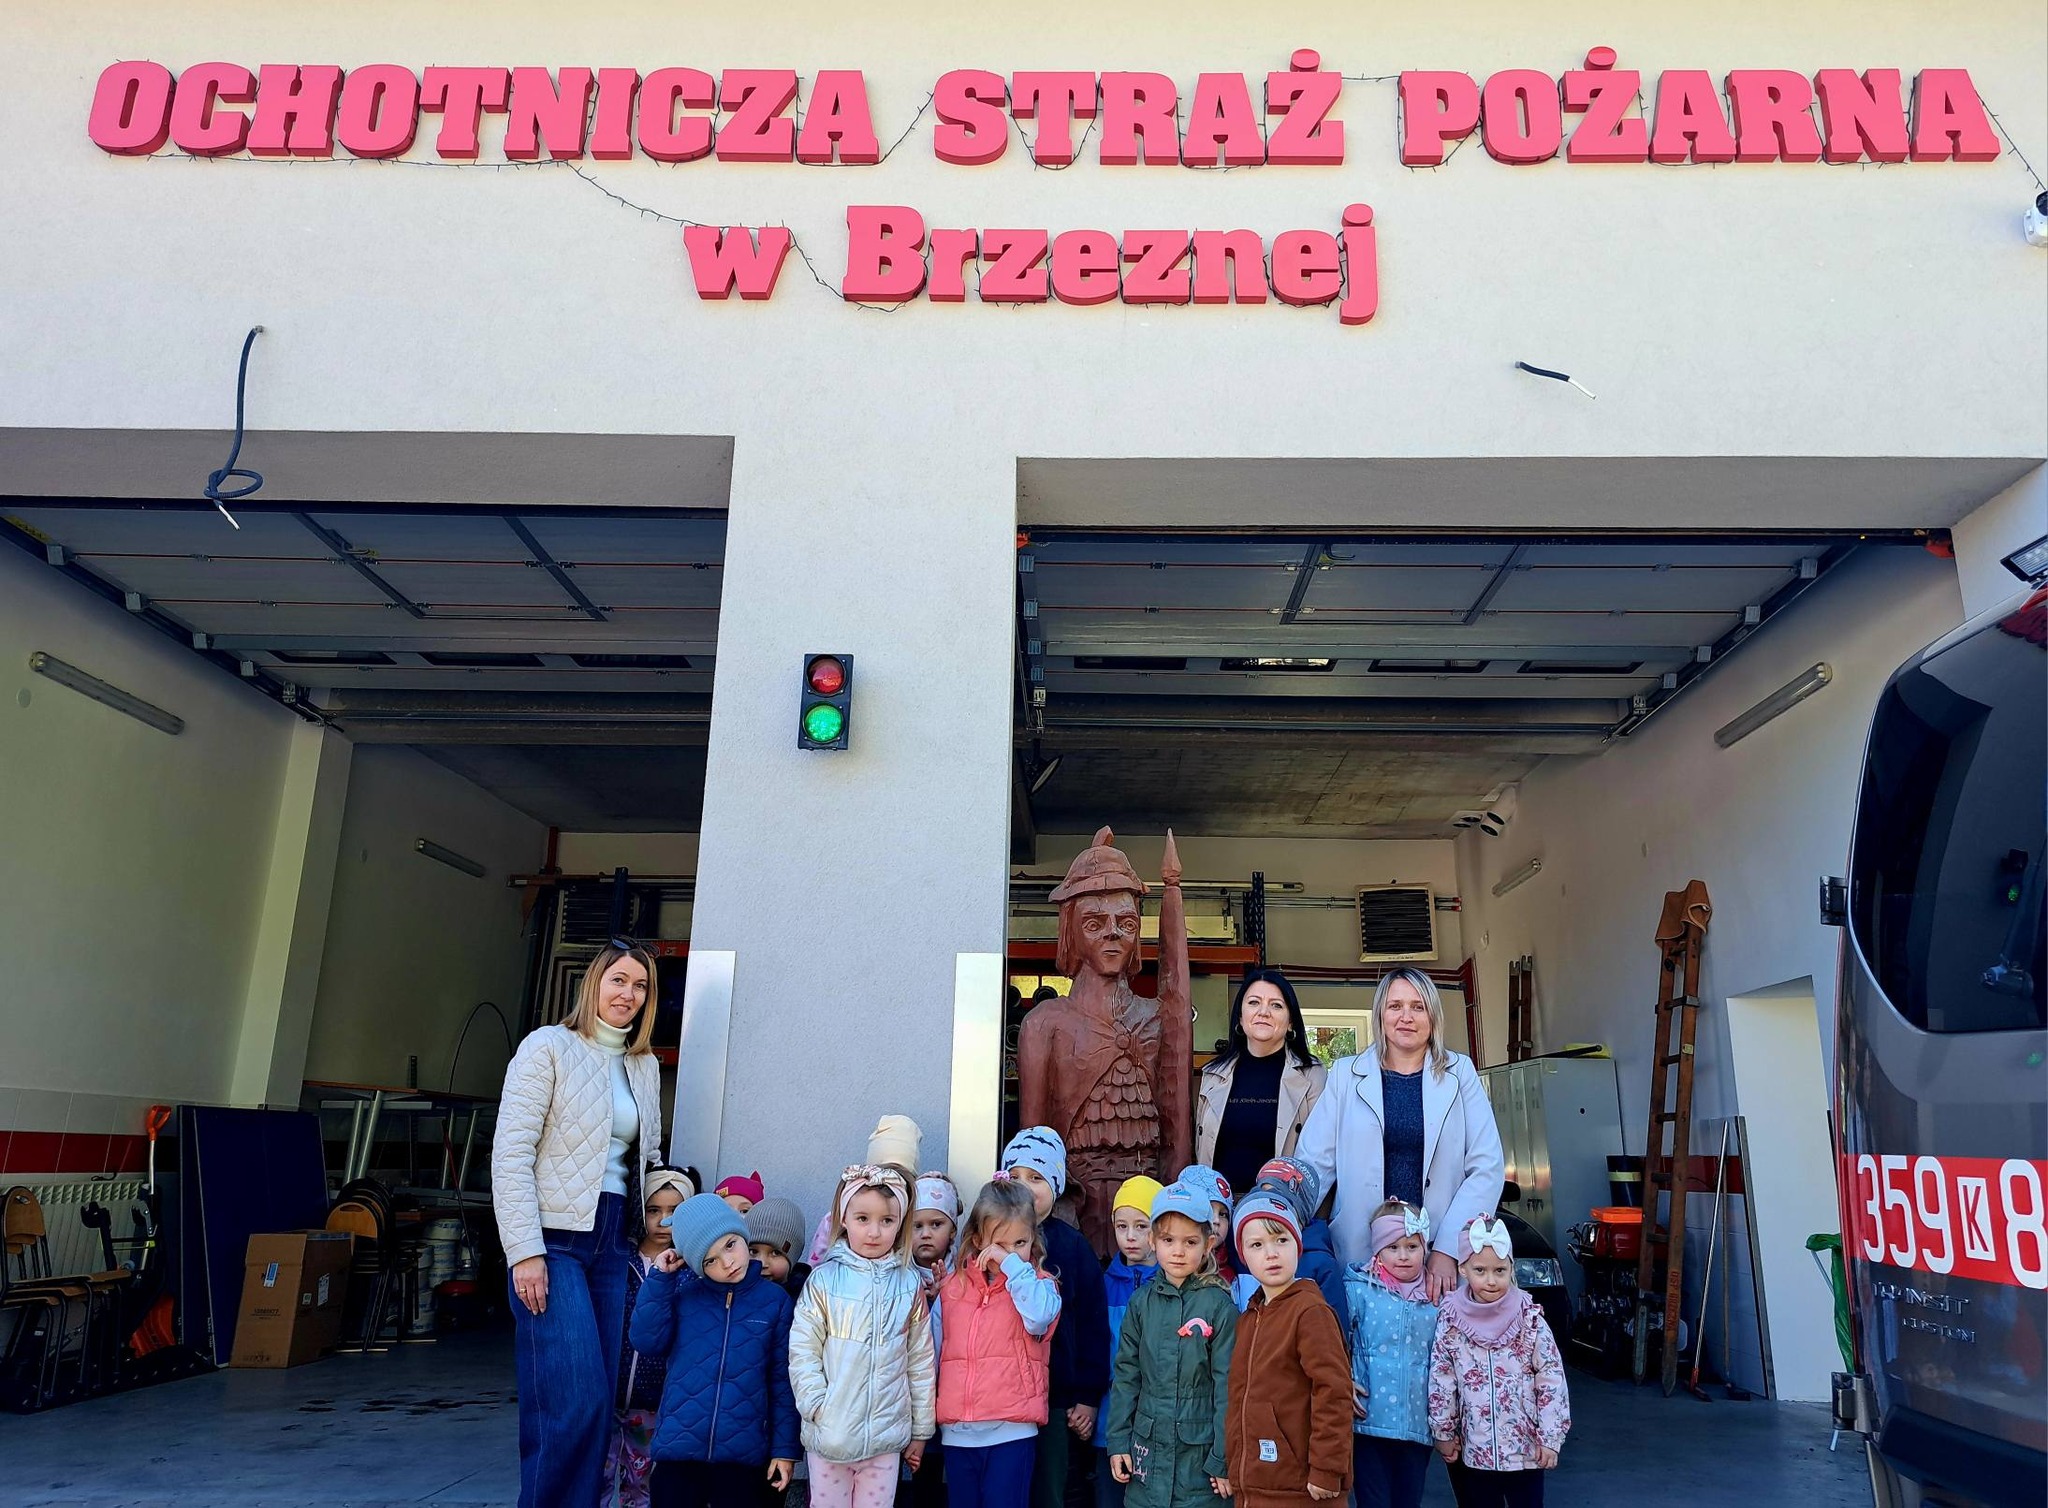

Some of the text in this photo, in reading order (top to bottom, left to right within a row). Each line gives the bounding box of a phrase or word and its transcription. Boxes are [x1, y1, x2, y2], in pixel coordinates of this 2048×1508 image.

[88, 46, 2001, 167] OCHOTNICZA STRAŻ POŻARNA
[684, 204, 1378, 325] w Brzeznej
